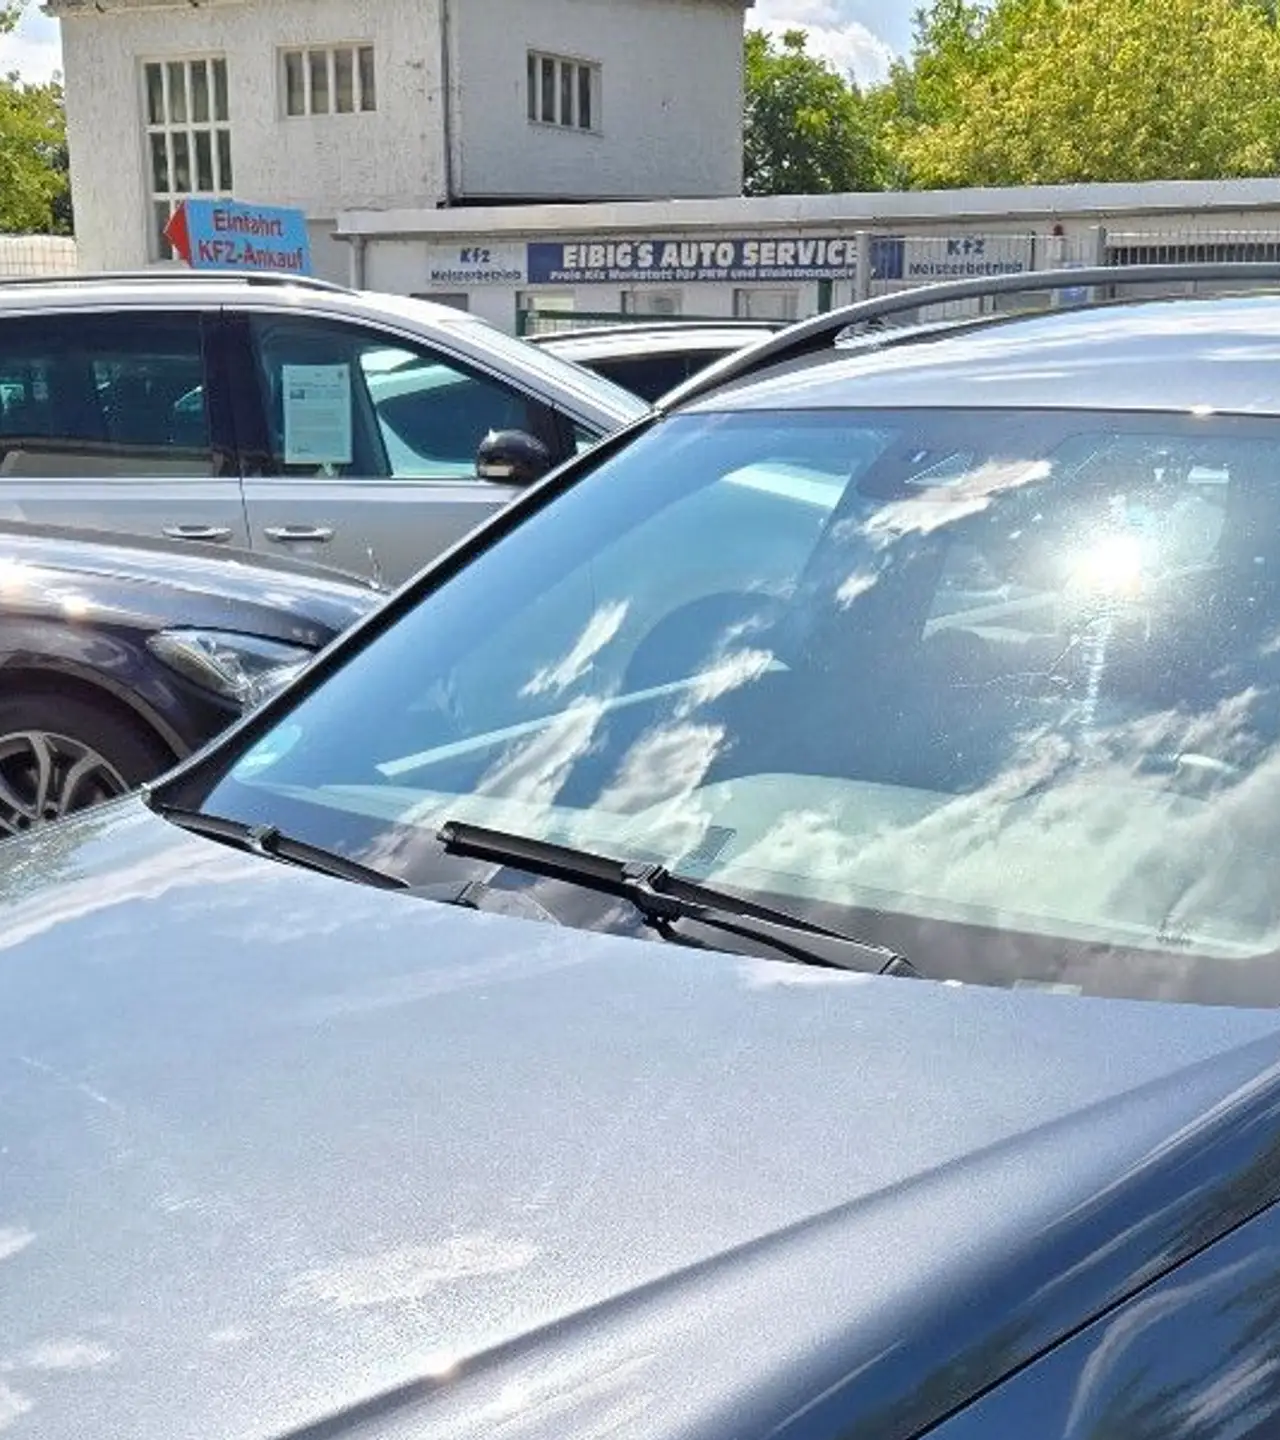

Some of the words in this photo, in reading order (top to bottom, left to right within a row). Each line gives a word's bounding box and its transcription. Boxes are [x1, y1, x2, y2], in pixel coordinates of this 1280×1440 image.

[213, 209, 283, 238] Einfahrt
[198, 239, 303, 270] KFZ-Ankauf
[460, 247, 491, 263] Kfz
[660, 240, 734, 267] AUTO
[742, 239, 859, 266] SERVICE
[431, 270, 521, 282] Meisterbetrieb
[908, 262, 1024, 276] Meisterbetrieb
